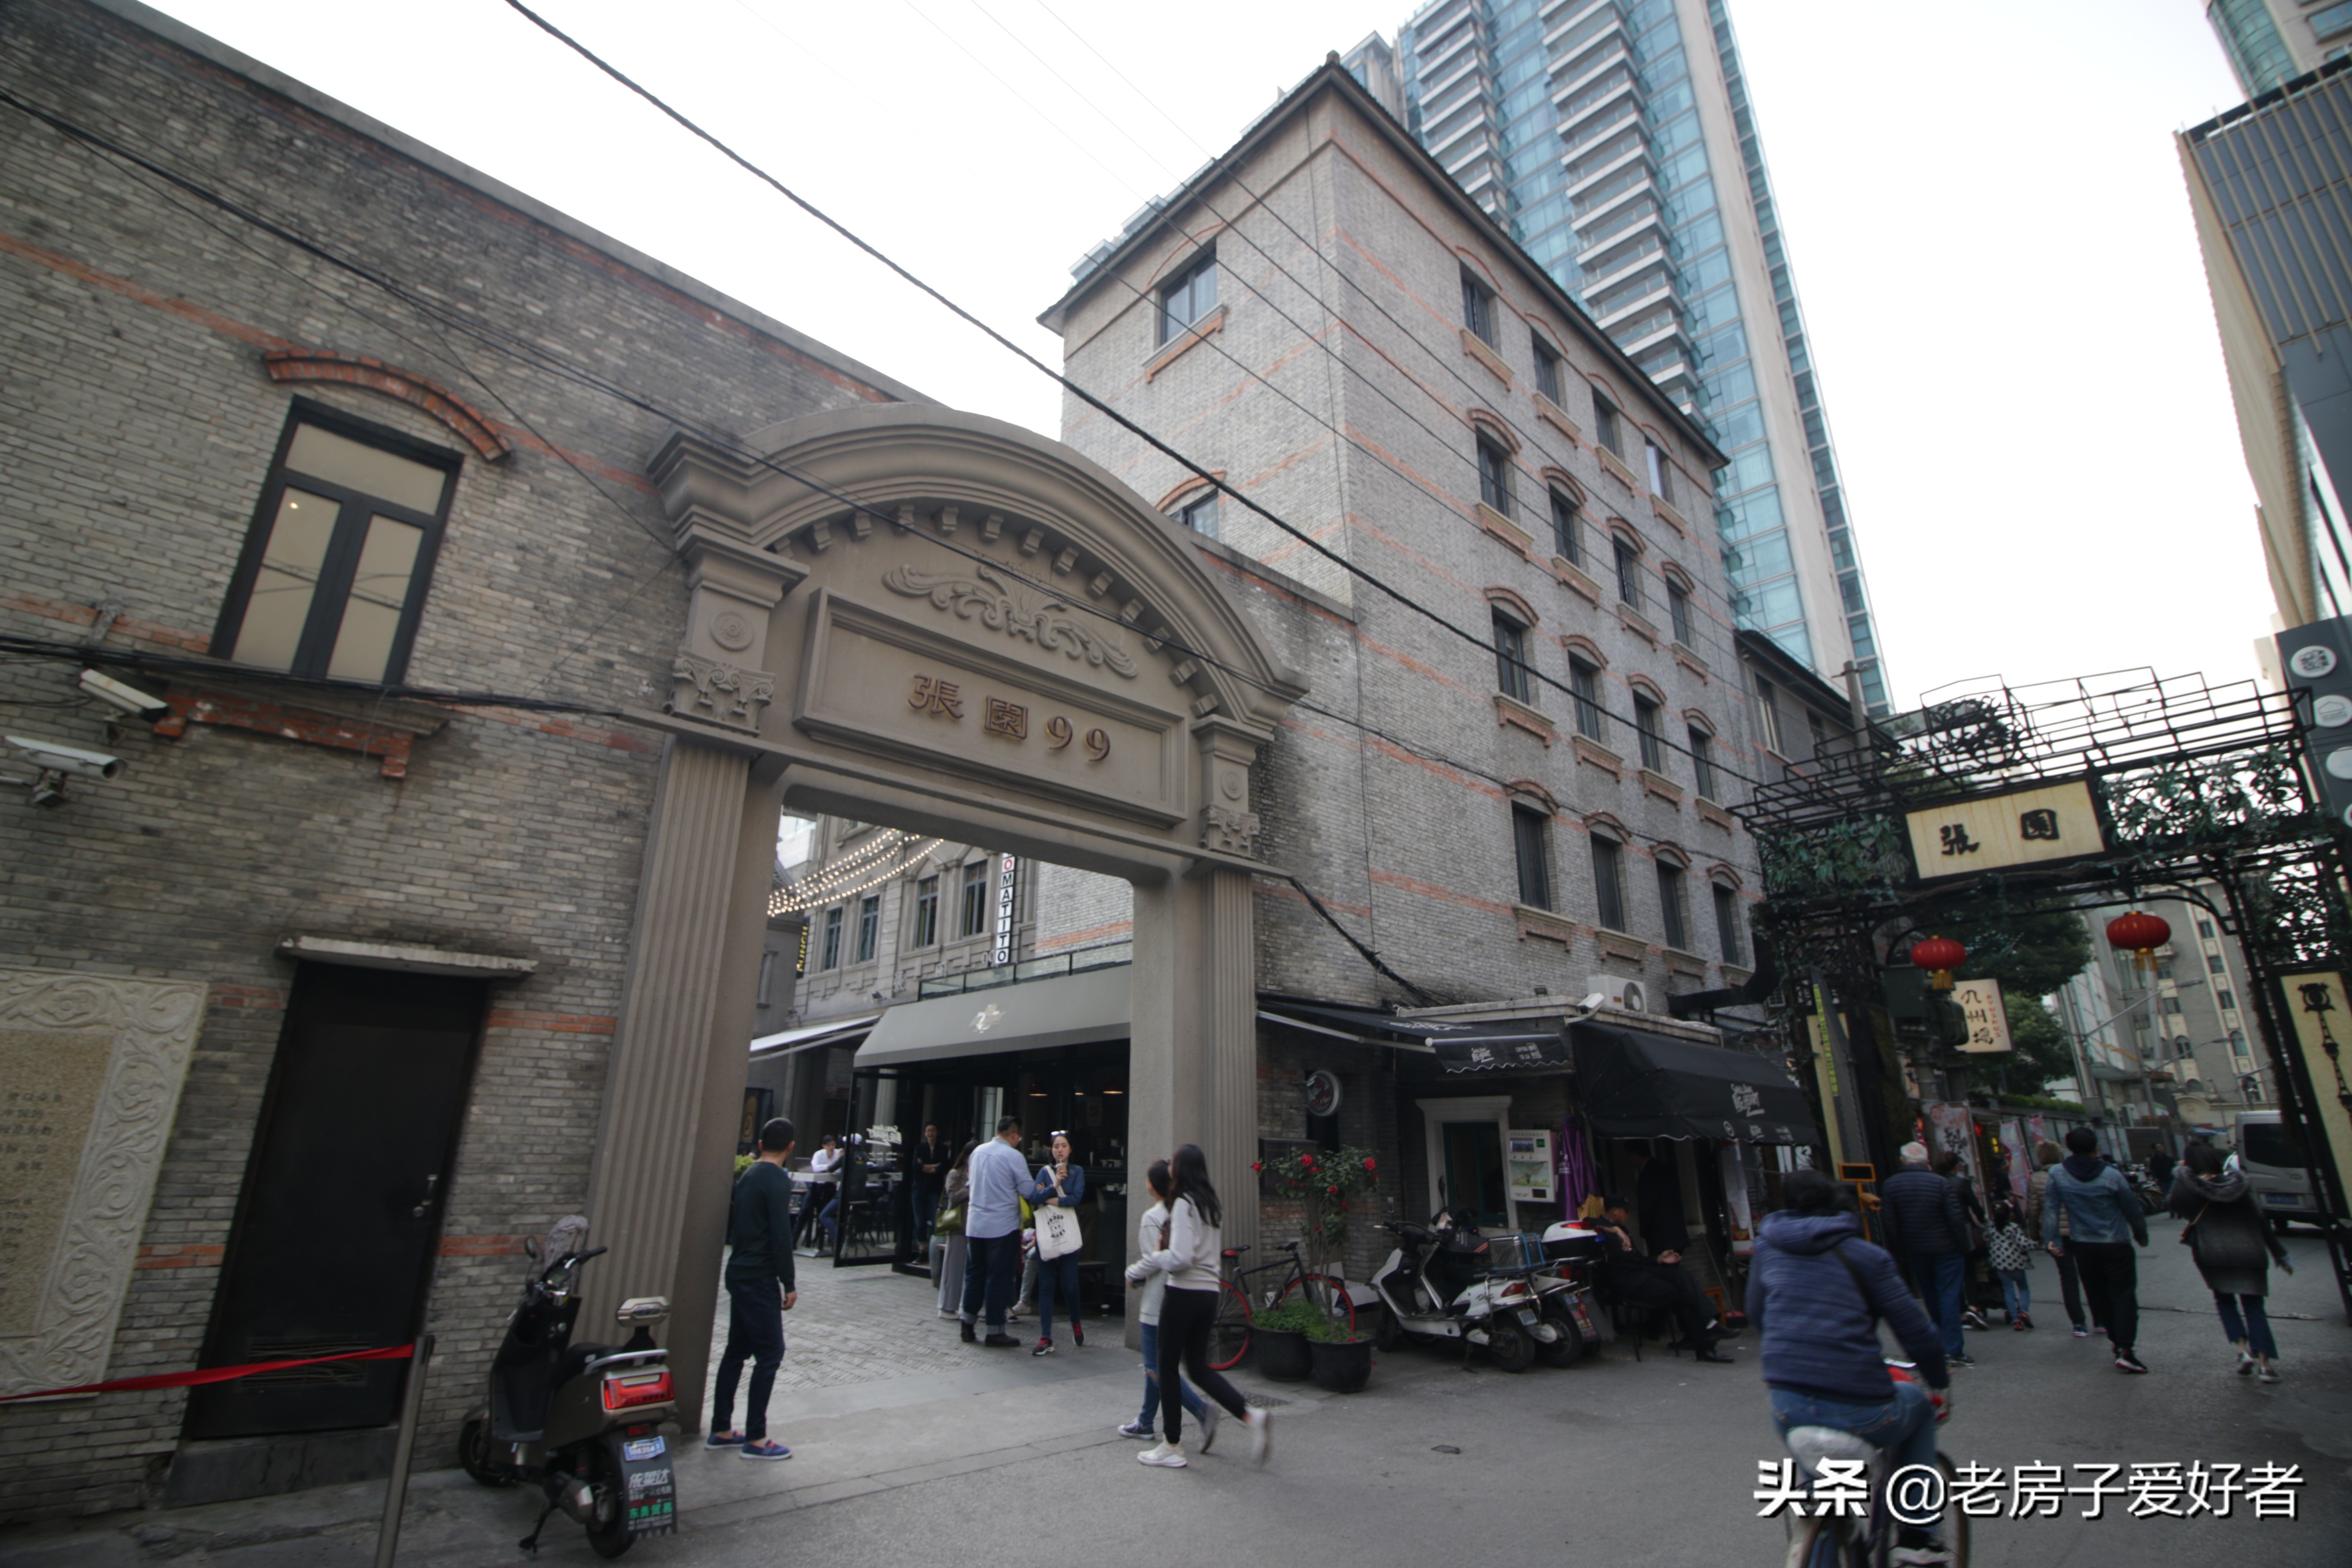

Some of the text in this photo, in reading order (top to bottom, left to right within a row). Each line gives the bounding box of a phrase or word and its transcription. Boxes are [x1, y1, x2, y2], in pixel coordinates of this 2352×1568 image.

[908, 673, 1111, 762] 張園99
[1940, 809, 2060, 855] 張園
[997, 859, 1012, 962] OMATITO
